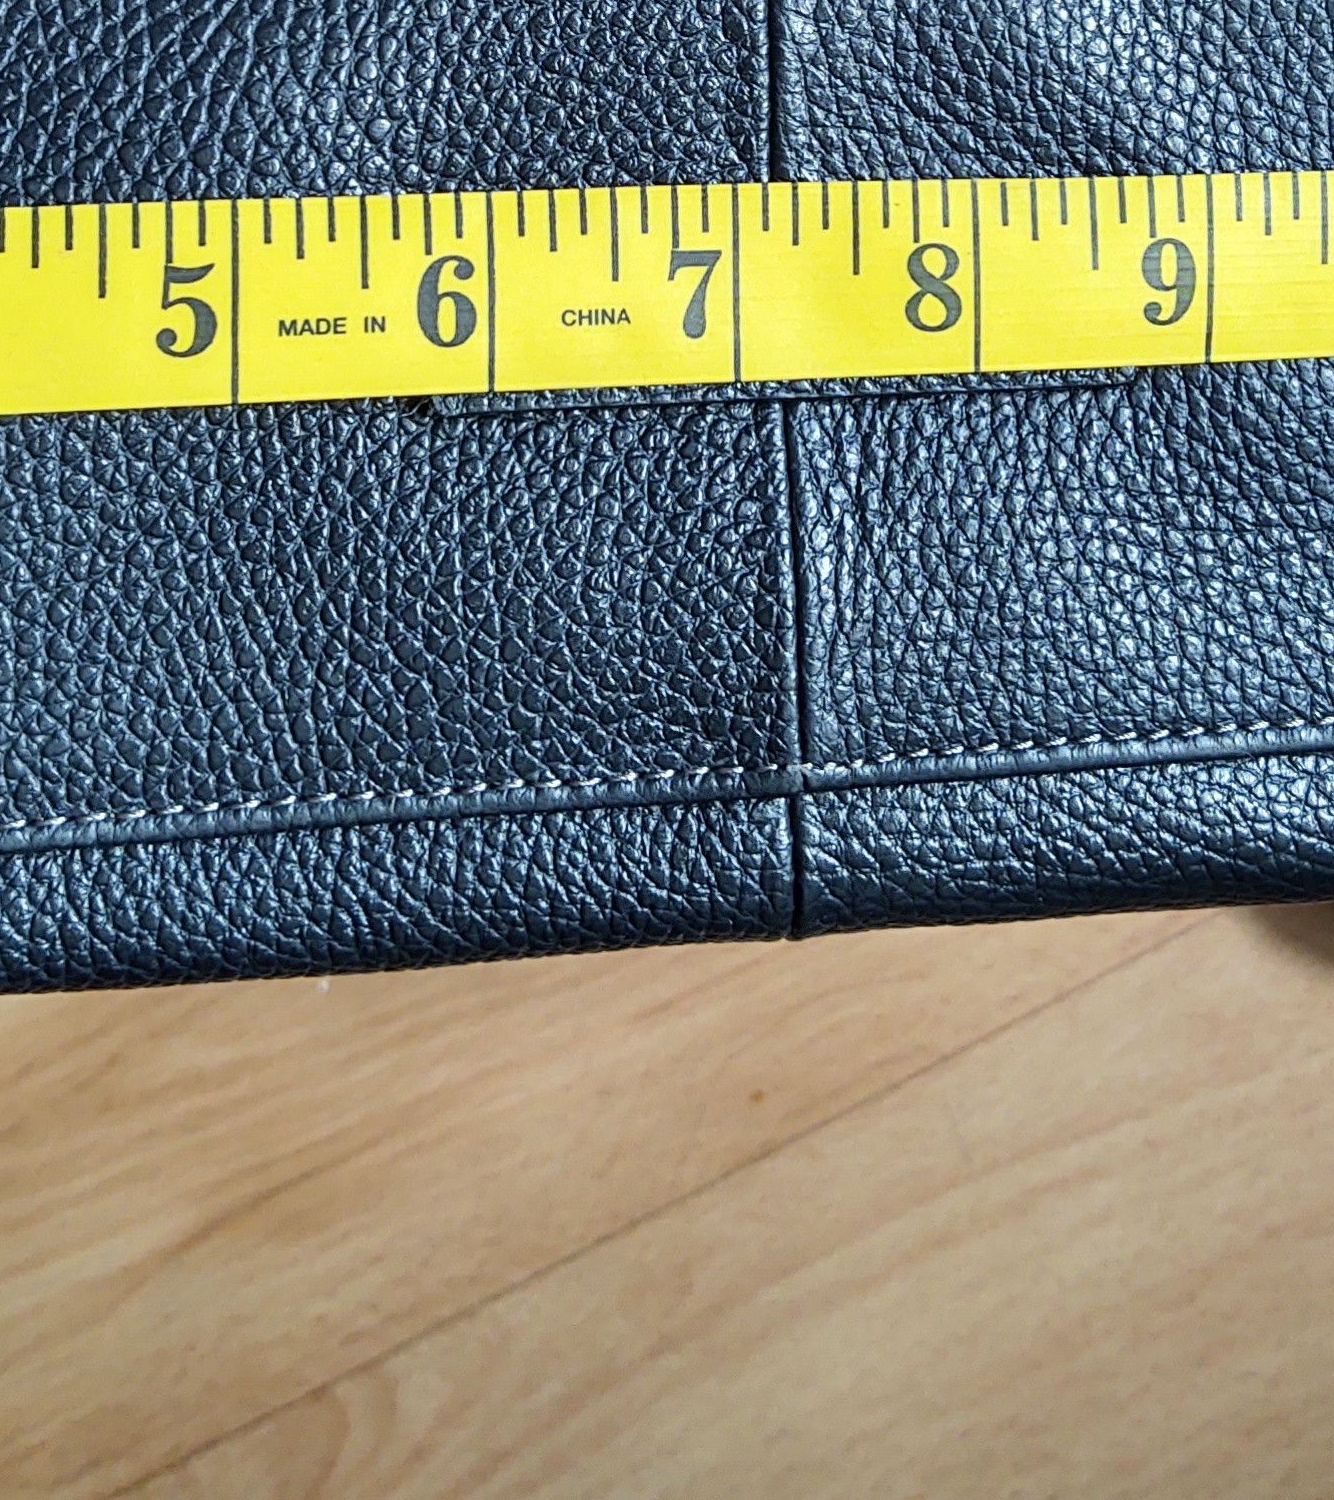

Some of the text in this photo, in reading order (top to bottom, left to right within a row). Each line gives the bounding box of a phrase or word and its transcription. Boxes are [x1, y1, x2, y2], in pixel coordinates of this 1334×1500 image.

[155, 263, 218, 358] 5
[277, 307, 631, 337] MADE IN CHINA
[416, 255, 478, 347] 6
[668, 250, 722, 339] 7
[905, 243, 963, 332] 8
[1141, 238, 1197, 326] 9
